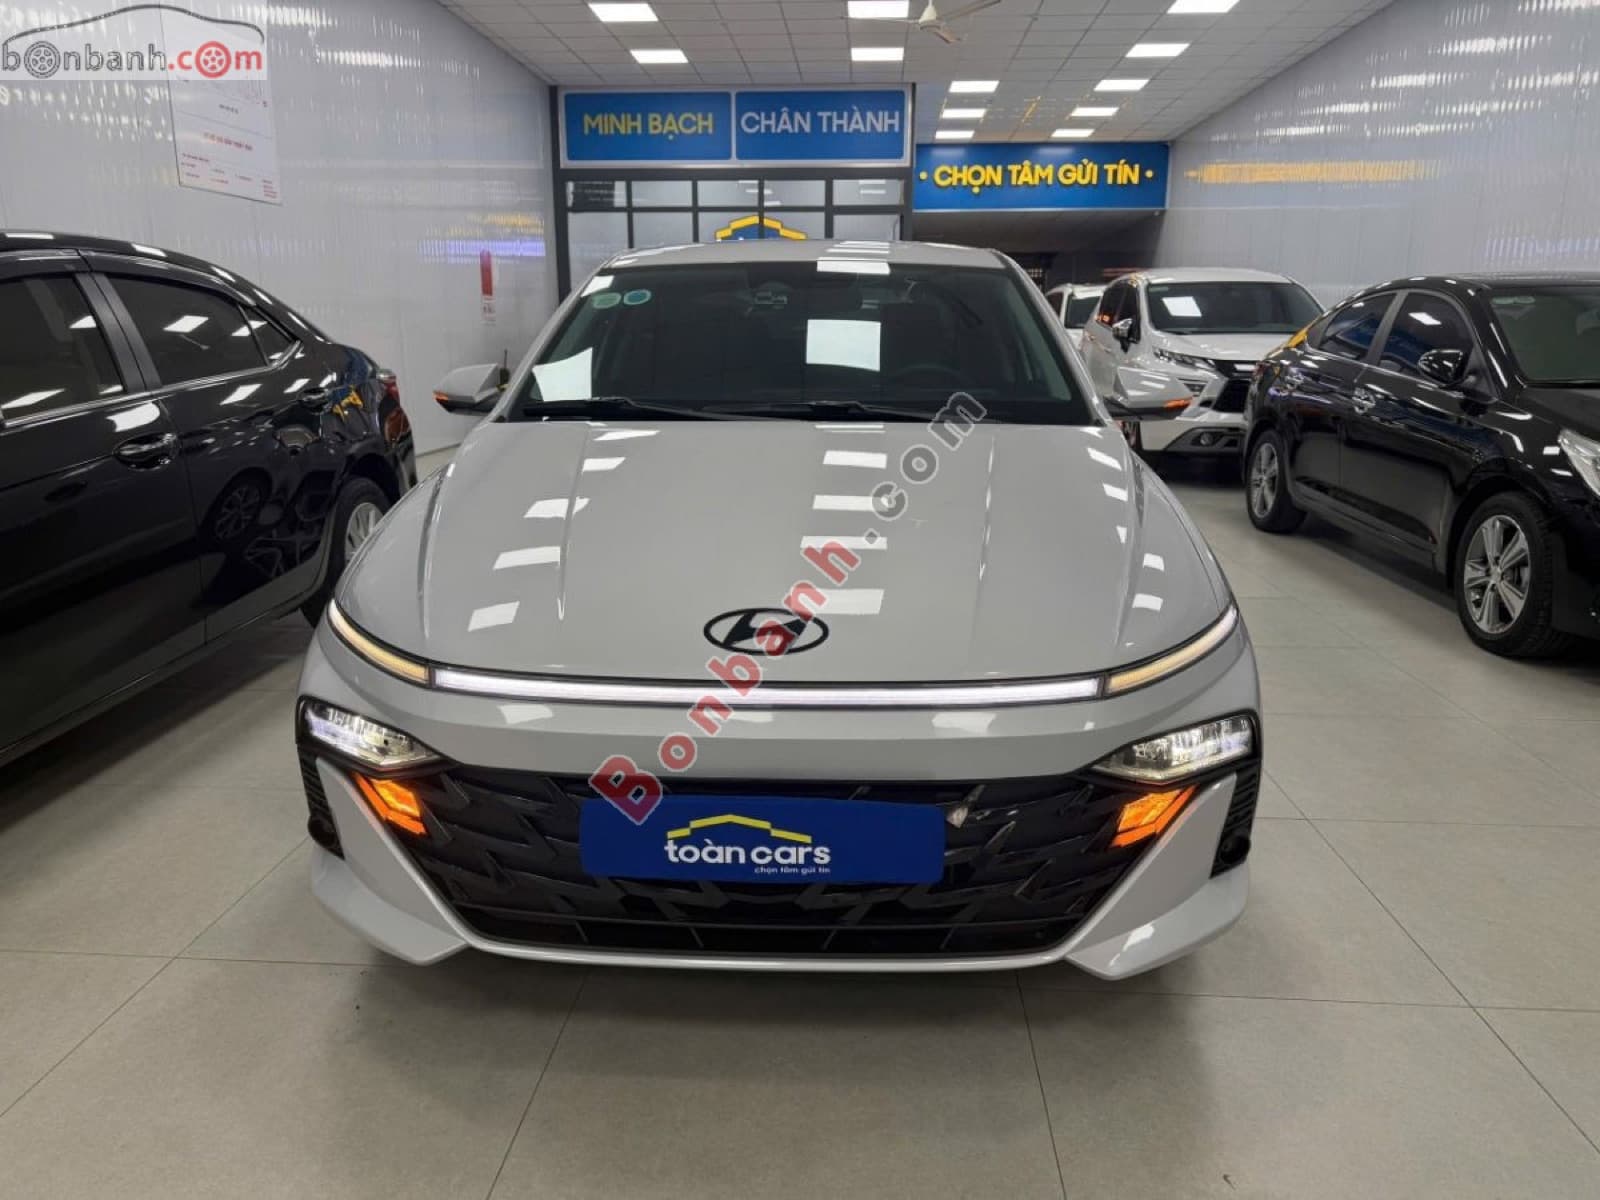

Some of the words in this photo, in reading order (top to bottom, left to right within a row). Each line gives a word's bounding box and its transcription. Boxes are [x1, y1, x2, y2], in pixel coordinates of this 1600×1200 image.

[584, 112, 642, 135] MINH
[649, 112, 714, 140] BẠCH
[740, 106, 811, 134] CHÂN
[817, 105, 900, 134] THÀNH
[933, 164, 1003, 194] CHỌN
[1008, 159, 1054, 186] TÂM
[1057, 158, 1099, 185] GỬI
[1103, 159, 1141, 185] TÍN
[664, 838, 746, 864] toàn
[751, 846, 832, 865] cars
